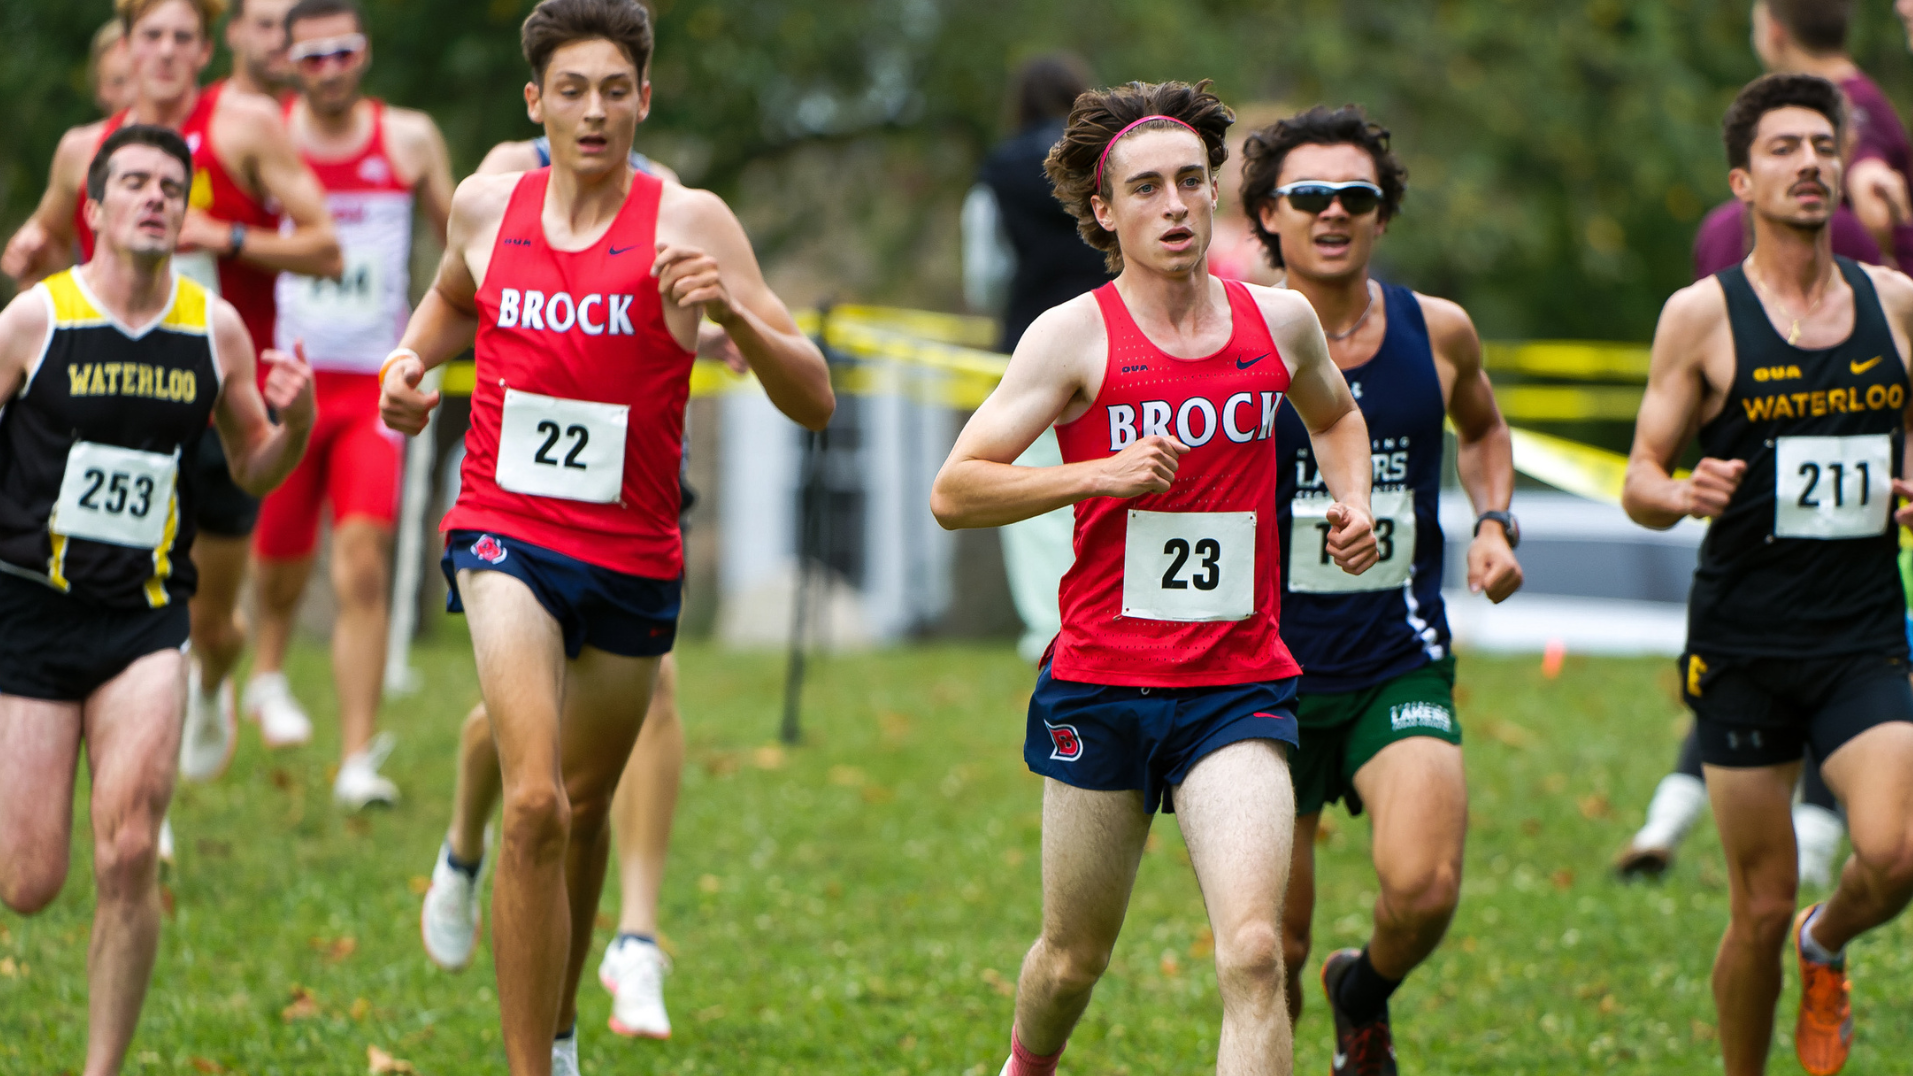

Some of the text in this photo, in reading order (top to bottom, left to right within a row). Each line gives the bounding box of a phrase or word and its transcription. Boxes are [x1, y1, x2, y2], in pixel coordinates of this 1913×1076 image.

[497, 287, 637, 337] BROCK
[68, 361, 197, 404] WATERLOO
[1121, 364, 1149, 373] OUA
[1753, 365, 1802, 382] OUA
[1742, 383, 1904, 422] WATERLOO
[534, 419, 590, 470] 22
[78, 468, 155, 518] 253
[1797, 460, 1870, 508] 211
[1161, 537, 1221, 591] 23
[1315, 518, 1395, 565] 13
